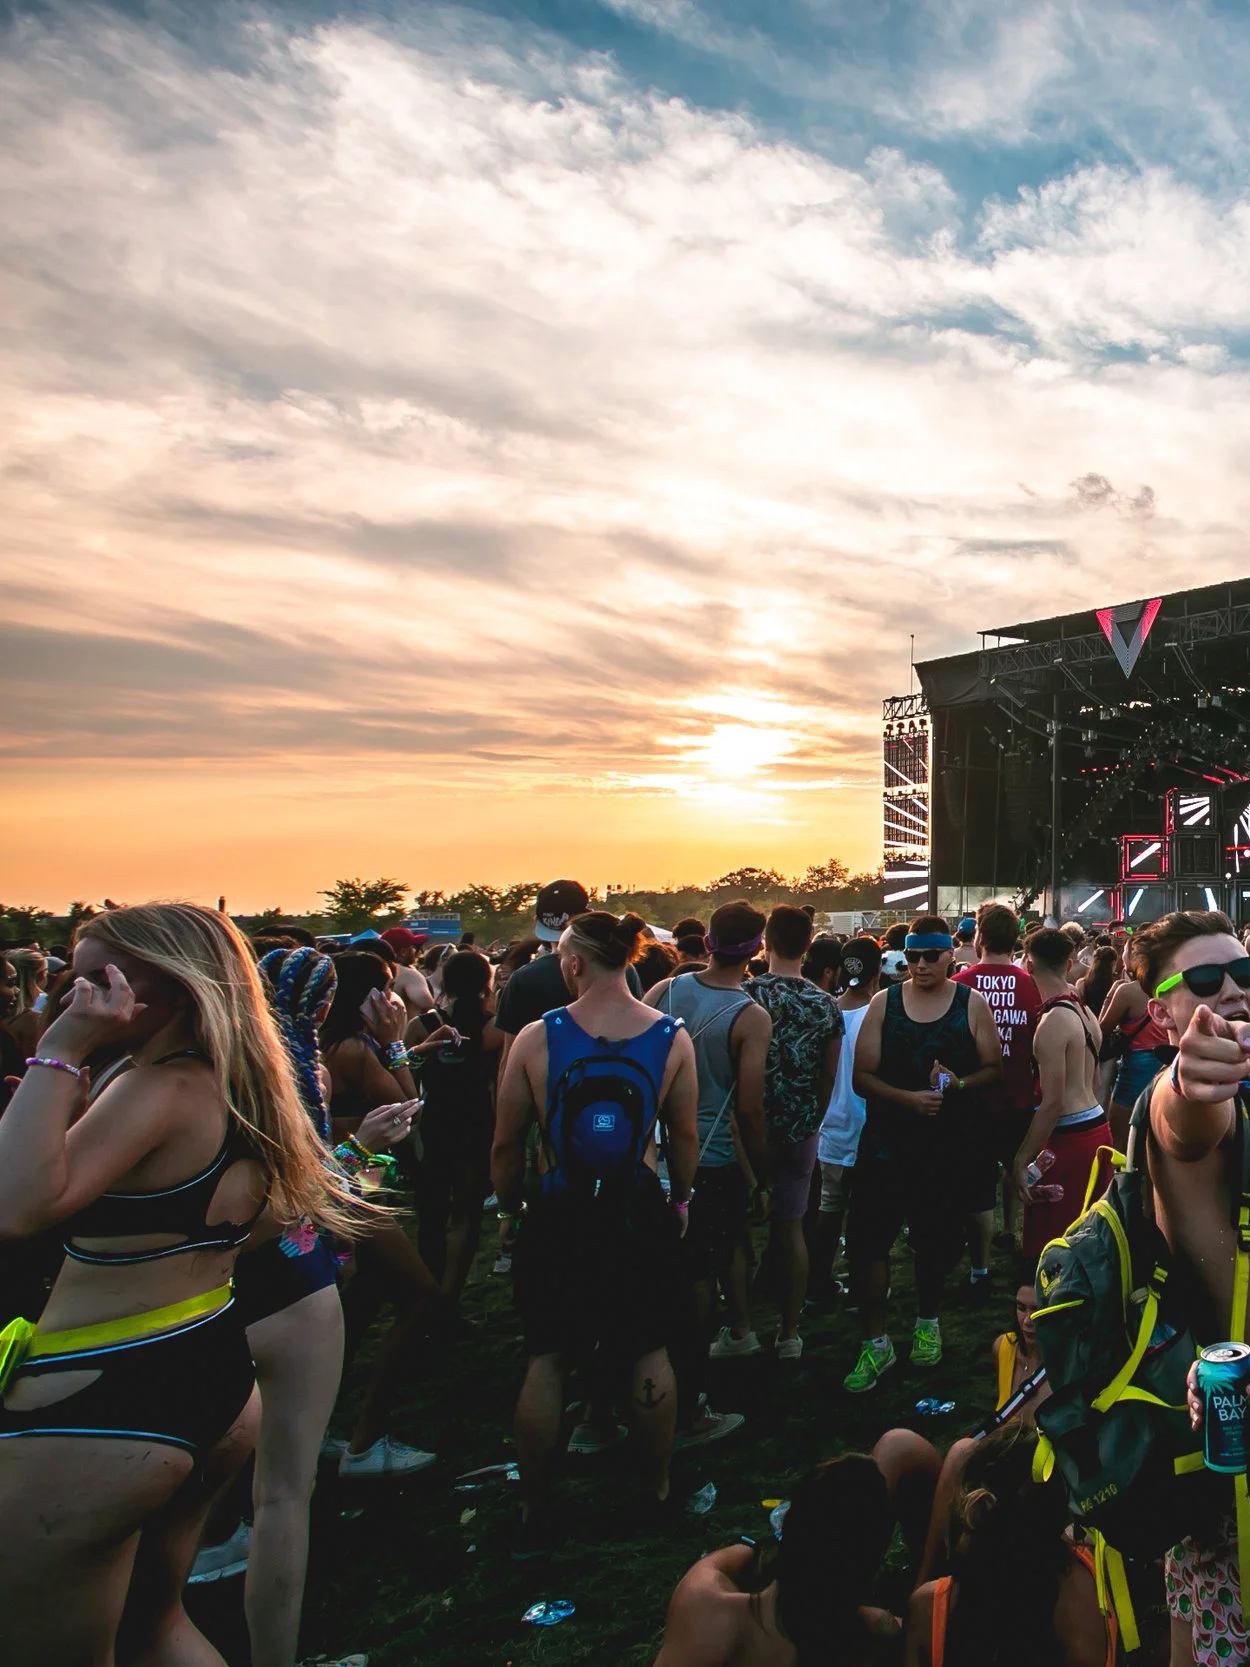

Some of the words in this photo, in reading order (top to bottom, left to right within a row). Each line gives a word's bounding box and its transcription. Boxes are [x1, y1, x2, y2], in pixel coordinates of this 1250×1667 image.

[975, 974, 1016, 990] TOKYO
[993, 1009, 1027, 1025] GAWA
[1213, 1394, 1250, 1409] PALM
[1218, 1406, 1247, 1422] BAY
[1093, 1483, 1118, 1505] 1210
